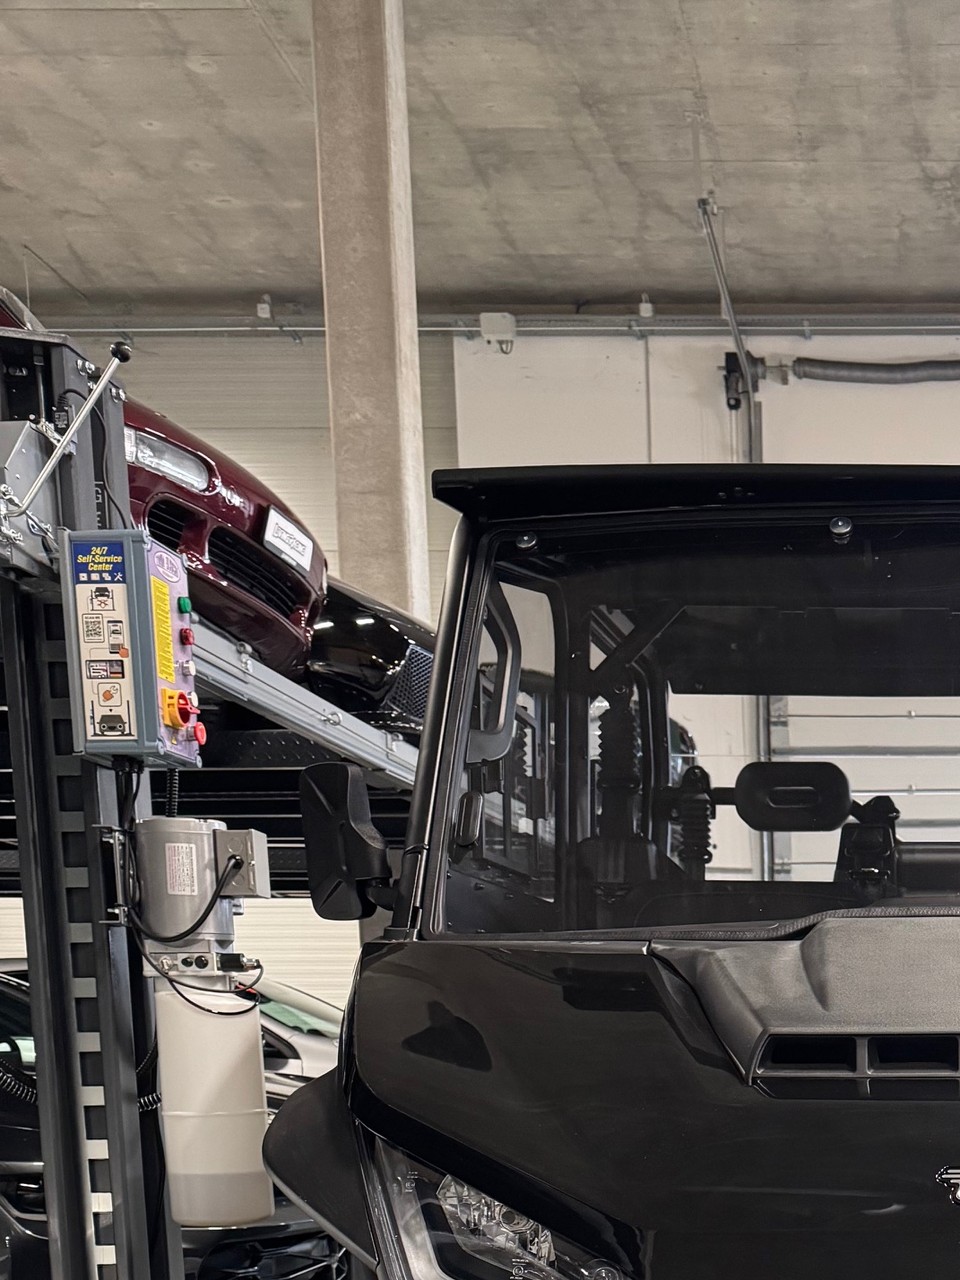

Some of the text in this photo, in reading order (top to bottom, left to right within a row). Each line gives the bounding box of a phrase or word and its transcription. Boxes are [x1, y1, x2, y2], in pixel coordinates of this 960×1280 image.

[91, 546, 108, 555] 24/7
[77, 554, 123, 563] Self-Service
[88, 562, 114, 571] Center
